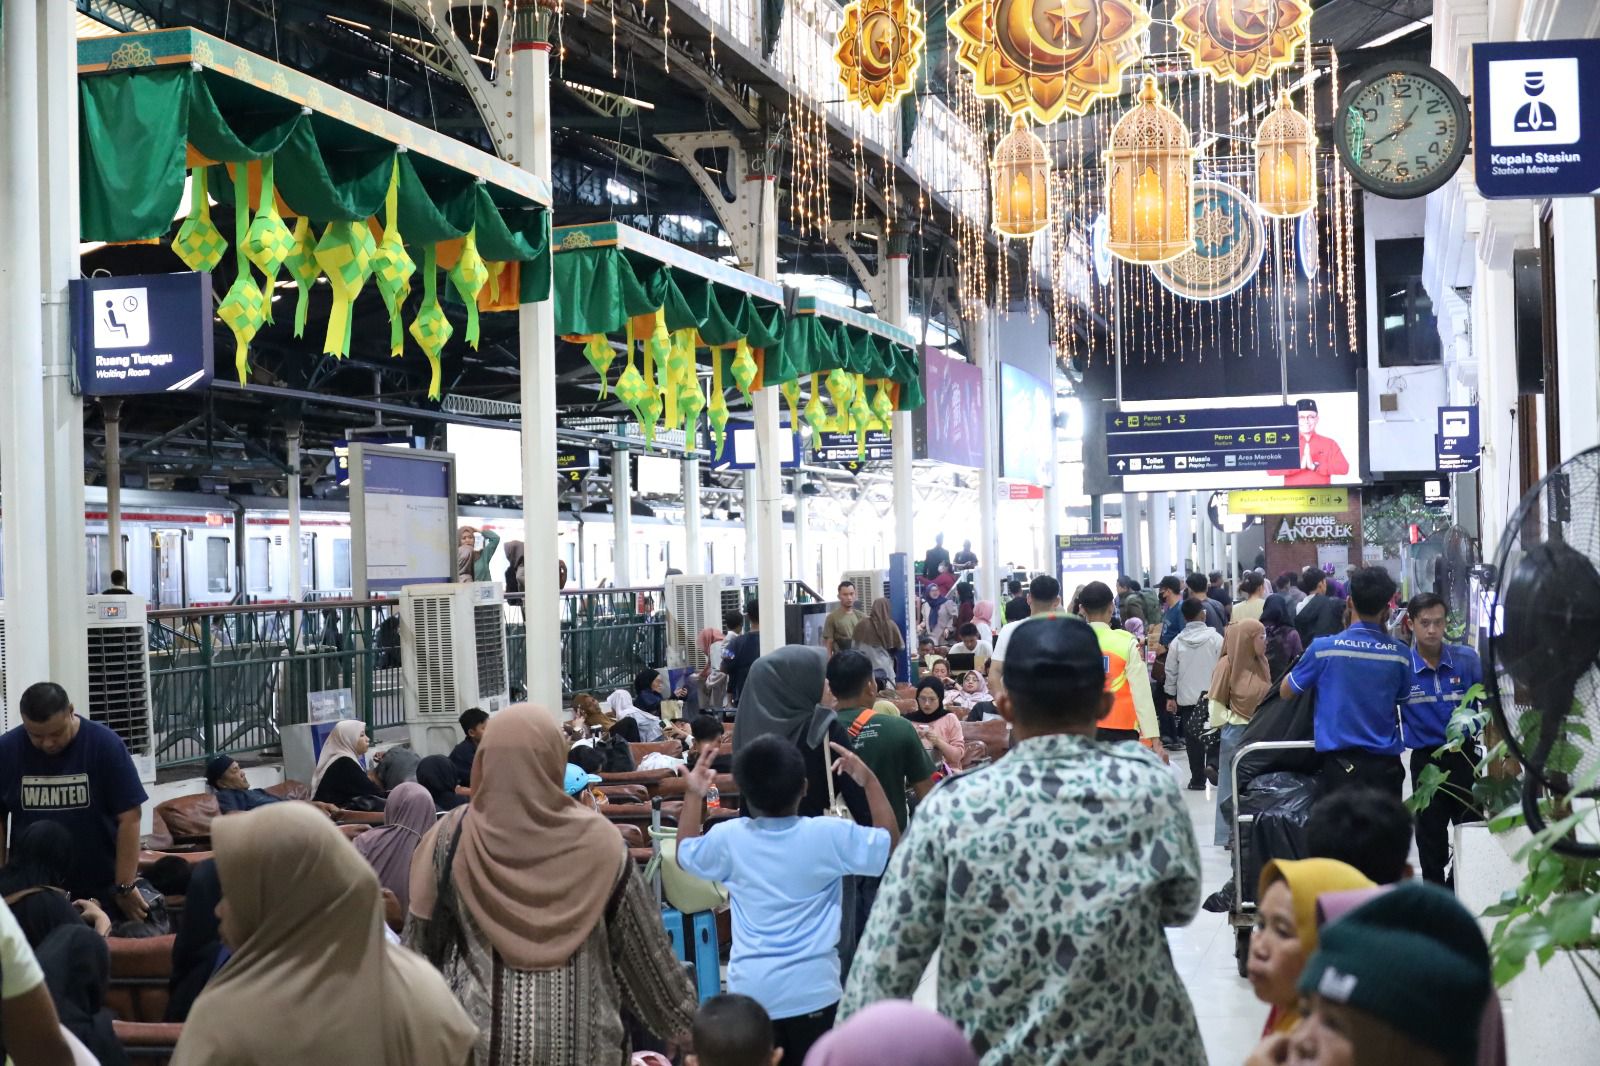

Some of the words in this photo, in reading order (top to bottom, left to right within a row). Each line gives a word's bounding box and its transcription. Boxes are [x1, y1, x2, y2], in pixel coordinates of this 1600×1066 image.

[1392, 84, 1412, 98] 12
[1416, 87, 1422, 101] 1
[1426, 99, 1441, 115] 2
[1434, 120, 1447, 136] 3
[1428, 141, 1440, 156] 4
[1378, 158, 1392, 173] 7
[1415, 155, 1430, 172] 5
[1491, 152, 1533, 166] Kepala
[1535, 150, 1581, 164] Stasiun
[1396, 161, 1409, 177] 6
[1491, 165, 1525, 176] Station
[1526, 165, 1559, 174] Master
[95, 355, 130, 367] Ruang
[131, 352, 173, 366] Tunggu
[96, 369, 126, 379] Waiting
[127, 368, 151, 377] Room
[1165, 415, 1171, 424] 1
[1178, 414, 1186, 423] 3
[1238, 434, 1246, 443] 4
[1253, 433, 1261, 442] 6
[570, 471, 580, 481] 2
[1295, 516, 1336, 526] LOUNGE
[1276, 517, 1353, 542] ANGGREK
[1334, 639, 1371, 649] FACILITY
[1374, 642, 1398, 652] CARE
[24, 785, 88, 807] WANTED
